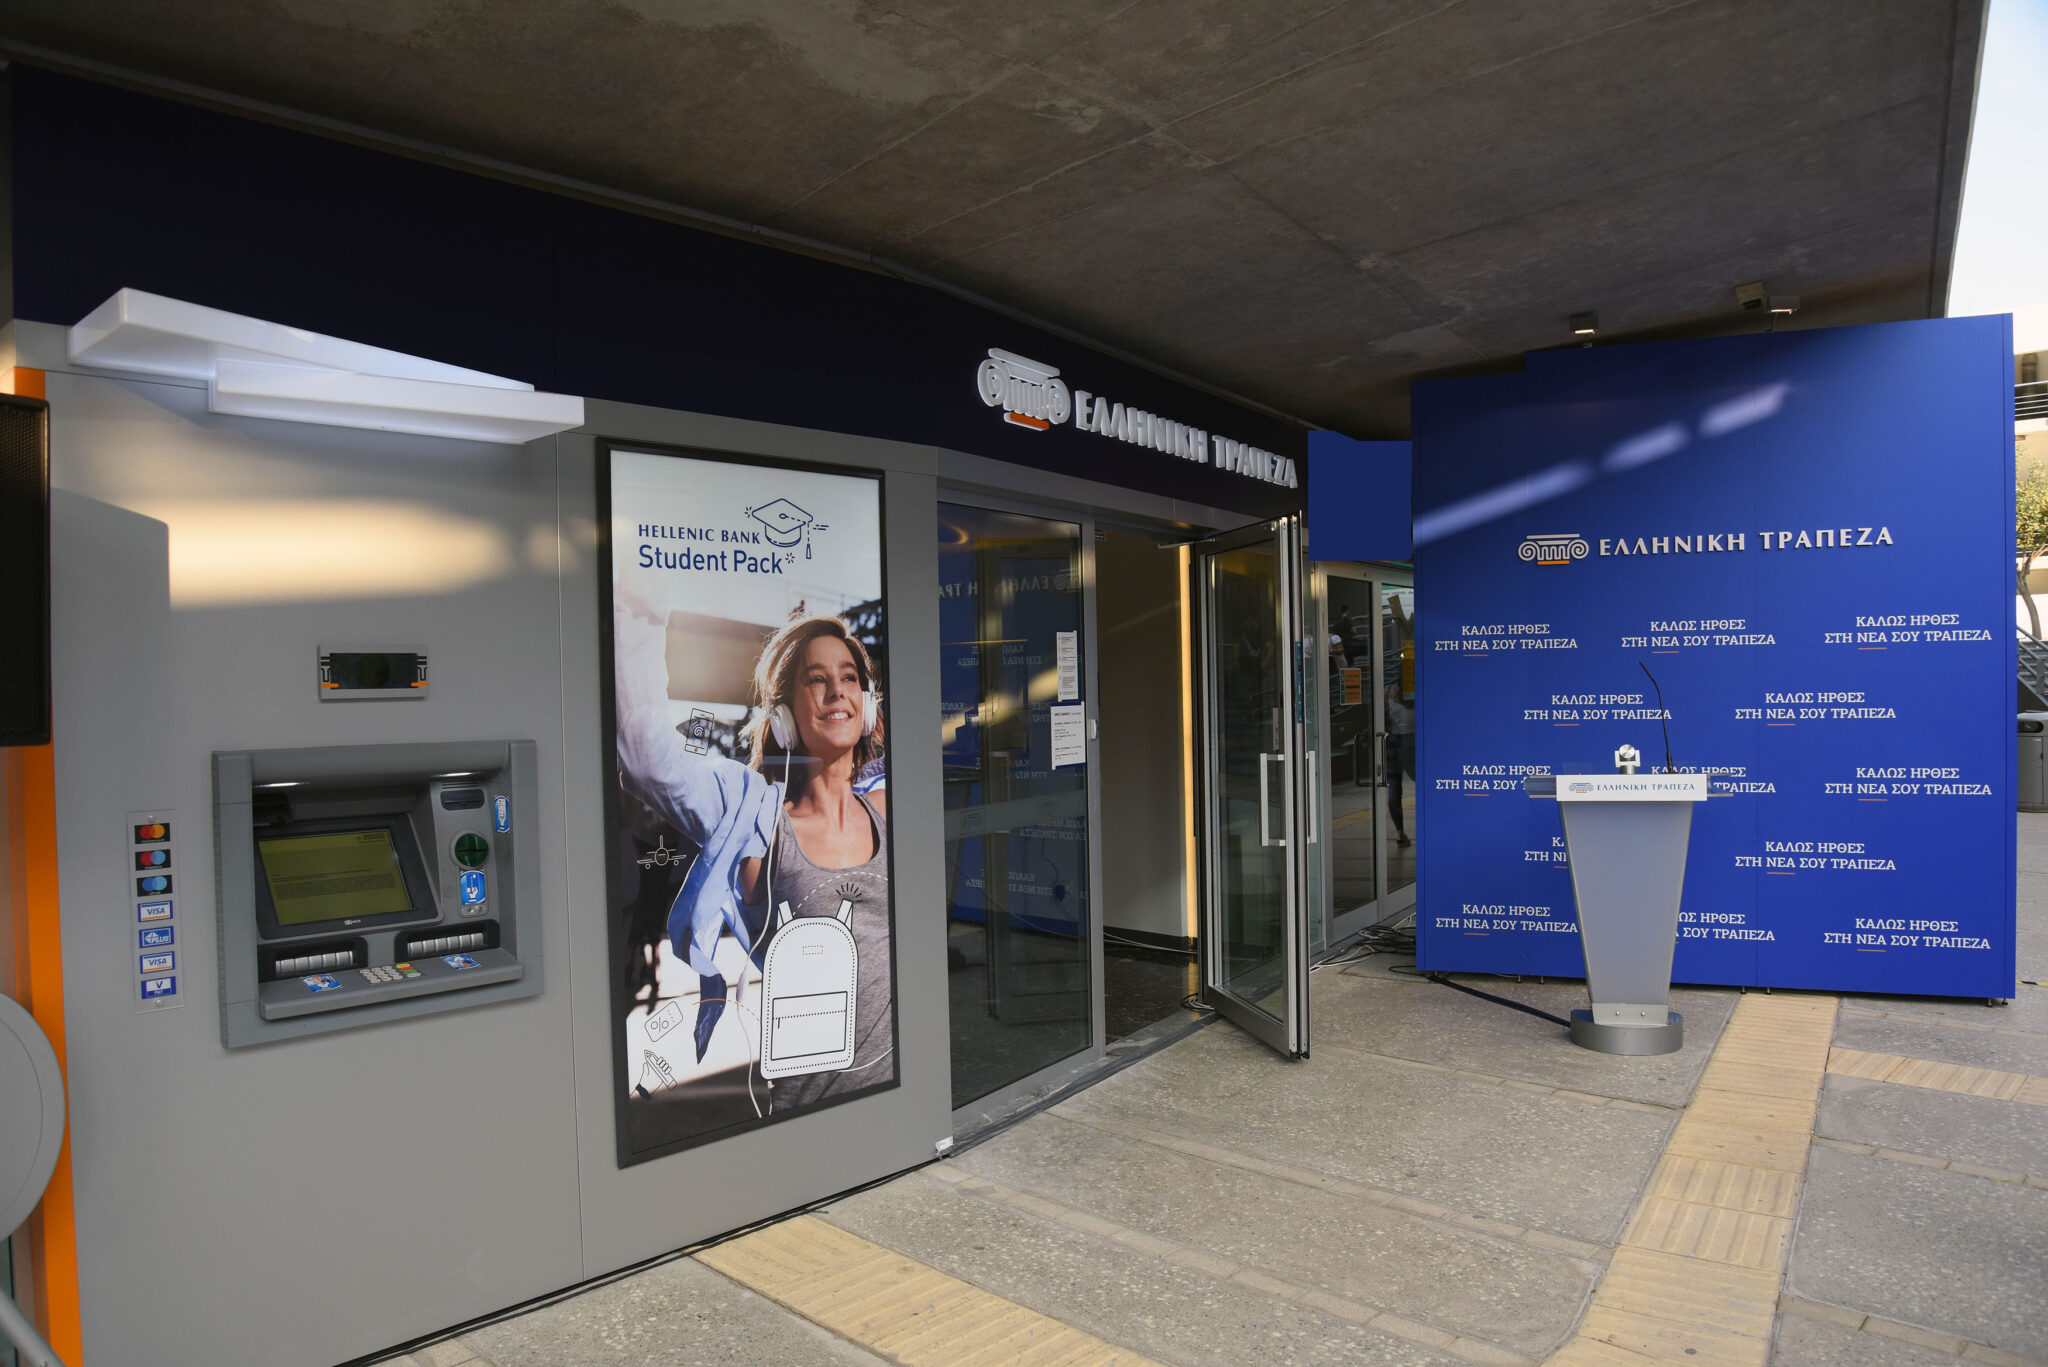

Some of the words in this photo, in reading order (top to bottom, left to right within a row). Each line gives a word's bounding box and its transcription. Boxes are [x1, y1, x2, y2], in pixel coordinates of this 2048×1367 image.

[1074, 390, 1208, 463] ΕΛΛΗΝΙΚΗ
[1212, 434, 1299, 489] ΤΡΑΠΕΖΑ
[638, 523, 714, 541] HELLENIC
[721, 530, 760, 544] BANK
[1600, 533, 1744, 555] ΕΛΛΗΝΙΚΗ
[1760, 527, 1893, 549] ΤΡΑΠΕΖΑ
[638, 544, 727, 572] Student
[733, 550, 783, 574] Pack
[1650, 620, 1697, 632] ΚΑΛΩΣ
[1700, 619, 1746, 631] ΗΡΘΕΣ
[1855, 615, 1907, 628] ΚΑΛΩΣ
[1909, 613, 1960, 626] ΗΡΘΕΣ
[1461, 624, 1505, 636] ΚΑΛΩΣ
[1508, 623, 1550, 635] ΗΡΘΕΣ
[1621, 636, 1648, 648] ΣΤΗ
[1651, 636, 1680, 647] ΝΕΑ
[1683, 635, 1710, 647] ΣΟΥ
[1712, 633, 1776, 646] ΤΡΑΠΕΖΑ
[1824, 632, 1853, 644] ΣΤΗ
[1856, 631, 1888, 643] ΝΕΑ
[1891, 630, 1921, 643] ΣΟΥ
[1923, 629, 1993, 642] ΤΡΑΠΕΖΑ
[1435, 640, 1459, 651] ΣΤΗ
[1462, 640, 1489, 650] ΝΕΑ
[1492, 639, 1517, 650] ΣΟΥ
[1519, 638, 1578, 649] ΤΡΑΠΕΖΑ
[1551, 694, 1597, 705] ΚΑΛΩΣ
[1599, 694, 1644, 705] ΗΡΘΕΣ
[1765, 692, 1814, 704] ΚΑΛΩΣ
[1817, 691, 1866, 703] ΗΡΘΕΣ
[1523, 709, 1549, 720] ΣΤΗ
[1552, 709, 1580, 720] ΝΕΑ
[1582, 709, 1609, 720] ΣΟΥ
[1611, 709, 1673, 720] ΤΡΑΠΕΖΑ
[1735, 708, 1763, 720] ΣΤΗ
[1765, 708, 1797, 720] ΝΕΑ
[1799, 708, 1828, 719] ΣΟΥ
[1830, 707, 1897, 719] ΤΡΑΠΕΖΑ
[1462, 765, 1506, 776] ΚΑΛΩΣ
[1508, 765, 1552, 776] ΗΡΘΕΣ
[1856, 767, 1907, 779] ΚΑΛΩΣ
[1910, 767, 1960, 779] ΗΡΘΕΣ
[1435, 779, 1460, 790] ΣΤΗ
[1463, 779, 1490, 790] ΝΕΑ
[1492, 779, 1518, 790] ΣΟΥ
[1596, 783, 1648, 792] ΕΛΛΗΝΙΚΗ
[1651, 783, 1696, 791] ΤΡΑΠΕΖΑ
[1824, 782, 1854, 794] ΣΤΗ
[1856, 783, 1889, 795] ΝΕΑ
[1891, 783, 1921, 795] ΣΟΥ
[1923, 783, 1993, 796] ΤΡΑΠΕΖΑ
[1765, 841, 1814, 853] ΚΑΛΩΣ
[1817, 842, 1865, 854] ΗΡΘΕΣ
[1524, 850, 1549, 862] ΣΤΗ
[1735, 856, 1763, 868] ΣΤΗ
[1766, 856, 1796, 868] ΝΕΑ
[1799, 857, 1828, 869] ΣΟΥ
[1830, 858, 1897, 871] ΤΡΑΠΕΖΑ
[1462, 904, 1506, 916] ΚΑΛΩΣ
[1509, 905, 1551, 917] ΗΡΘΕΣ
[1435, 917, 1460, 928] ΣΤΗ
[1463, 918, 1490, 930] ΝΕΑ
[1492, 919, 1518, 931] ΣΟΥ
[1520, 920, 1579, 933] ΤΡΑΠΕΖΑ
[1700, 912, 1746, 925] ΗΡΘΕΣ
[1855, 918, 1906, 931] ΚΑΛΩΣ
[1909, 919, 1959, 933] ΗΡΘΕΣ
[151, 936, 169, 944] PLUS
[1682, 927, 1710, 939] ΣΟΥ
[1712, 928, 1776, 941] ΤΡΑΠΕΖΑ
[1823, 932, 1853, 944] ΣΤΗ
[1856, 933, 1887, 946] ΝΕΑ
[1890, 934, 1920, 947] ΣΟΥ
[1922, 936, 1991, 950] ΤΡΑΠΕΖΑ
[149, 958, 167, 966] VISA
